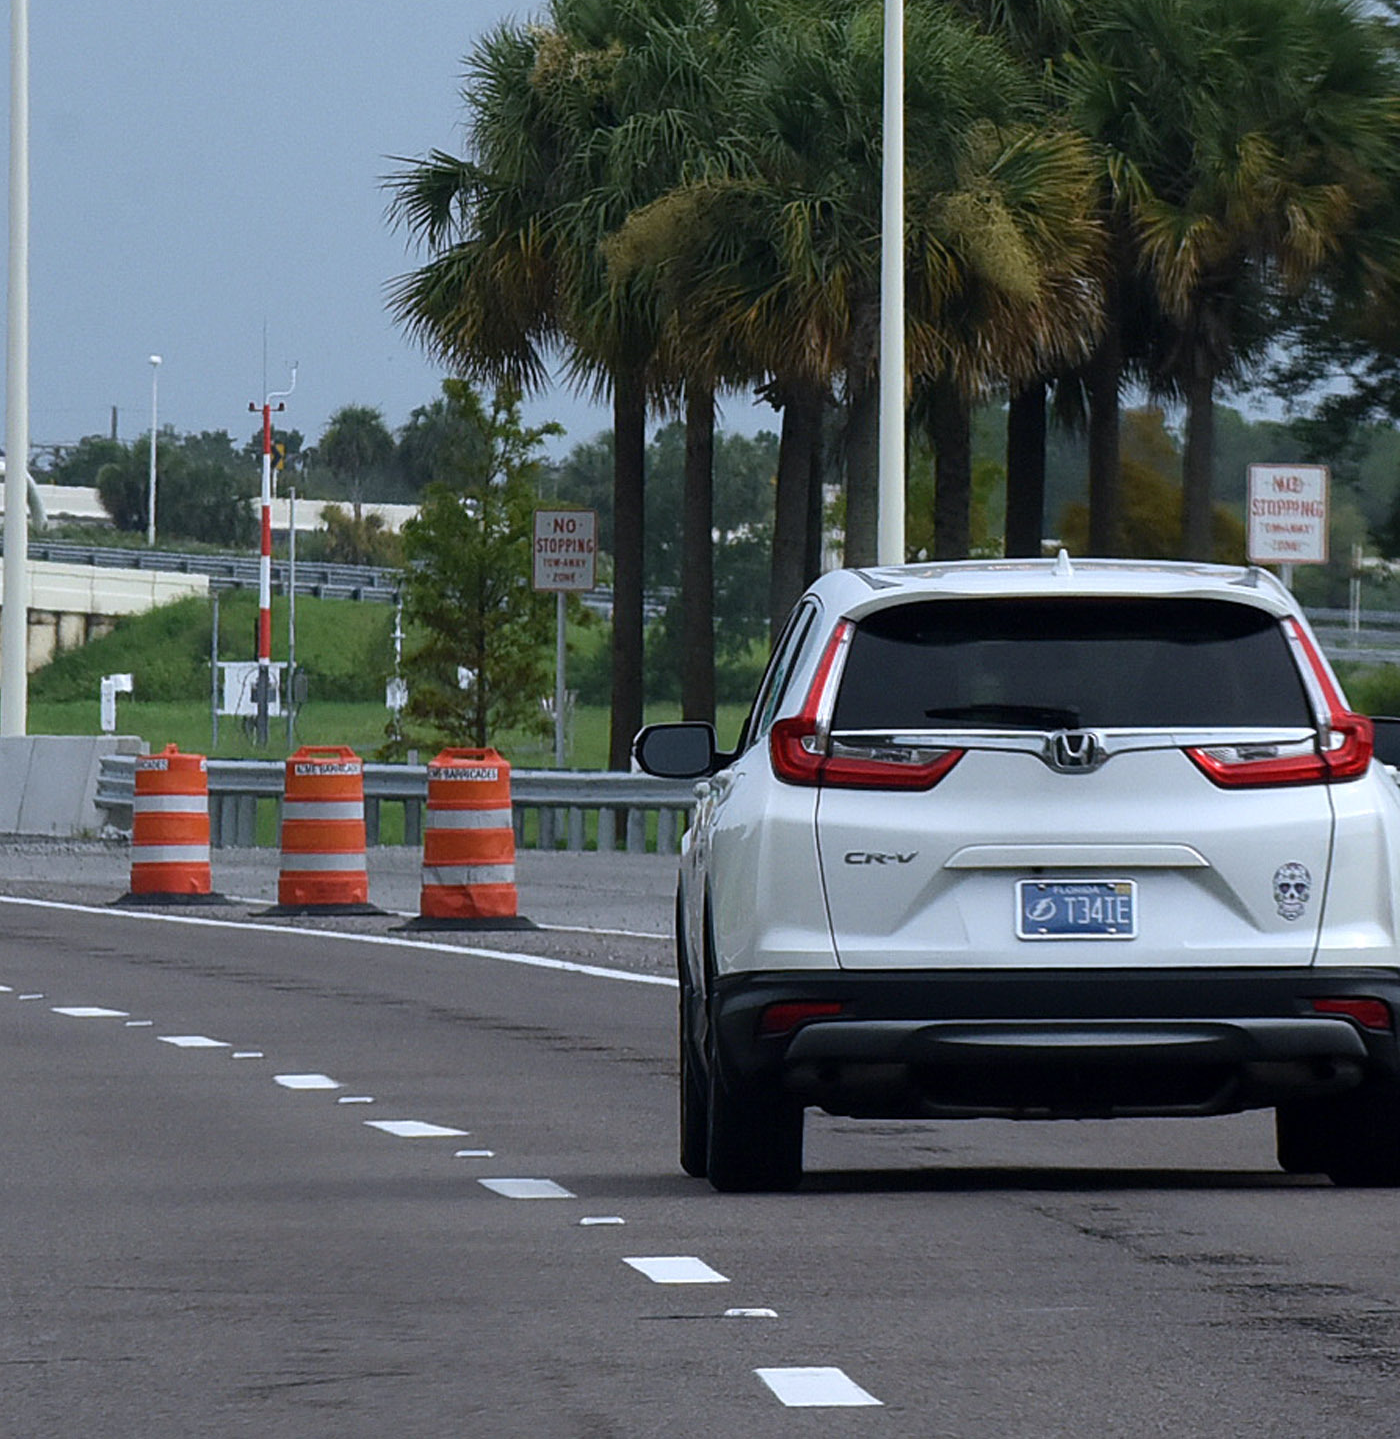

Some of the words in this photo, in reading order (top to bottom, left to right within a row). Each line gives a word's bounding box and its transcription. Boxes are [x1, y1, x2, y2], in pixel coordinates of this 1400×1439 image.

[1272, 475, 1304, 494] NO
[1252, 498, 1324, 518] STOPPING
[553, 518, 576, 534] NO
[536, 537, 594, 554] STOPPING
[844, 850, 919, 865] CR-V
